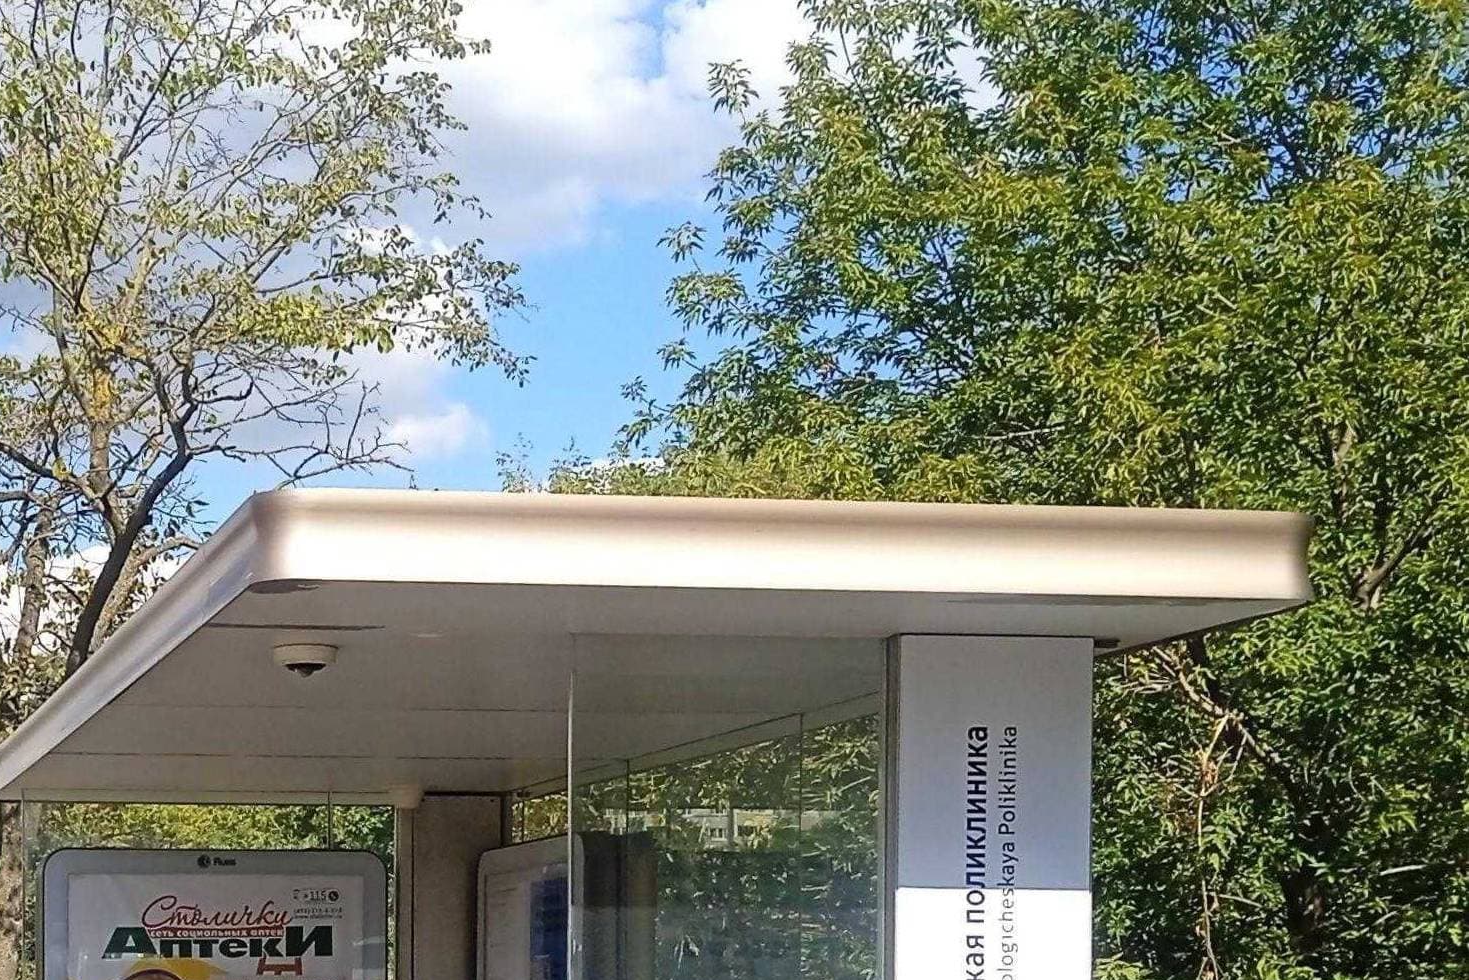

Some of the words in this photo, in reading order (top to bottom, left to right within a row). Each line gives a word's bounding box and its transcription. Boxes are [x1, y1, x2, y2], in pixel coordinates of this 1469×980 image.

[997, 725, 1018, 835] Poliklinika
[965, 725, 989, 924] поликлиника
[141, 894, 294, 929] Столички
[150, 930, 174, 939] сеть
[176, 930, 248, 940] социальных
[250, 929, 284, 939] аптек
